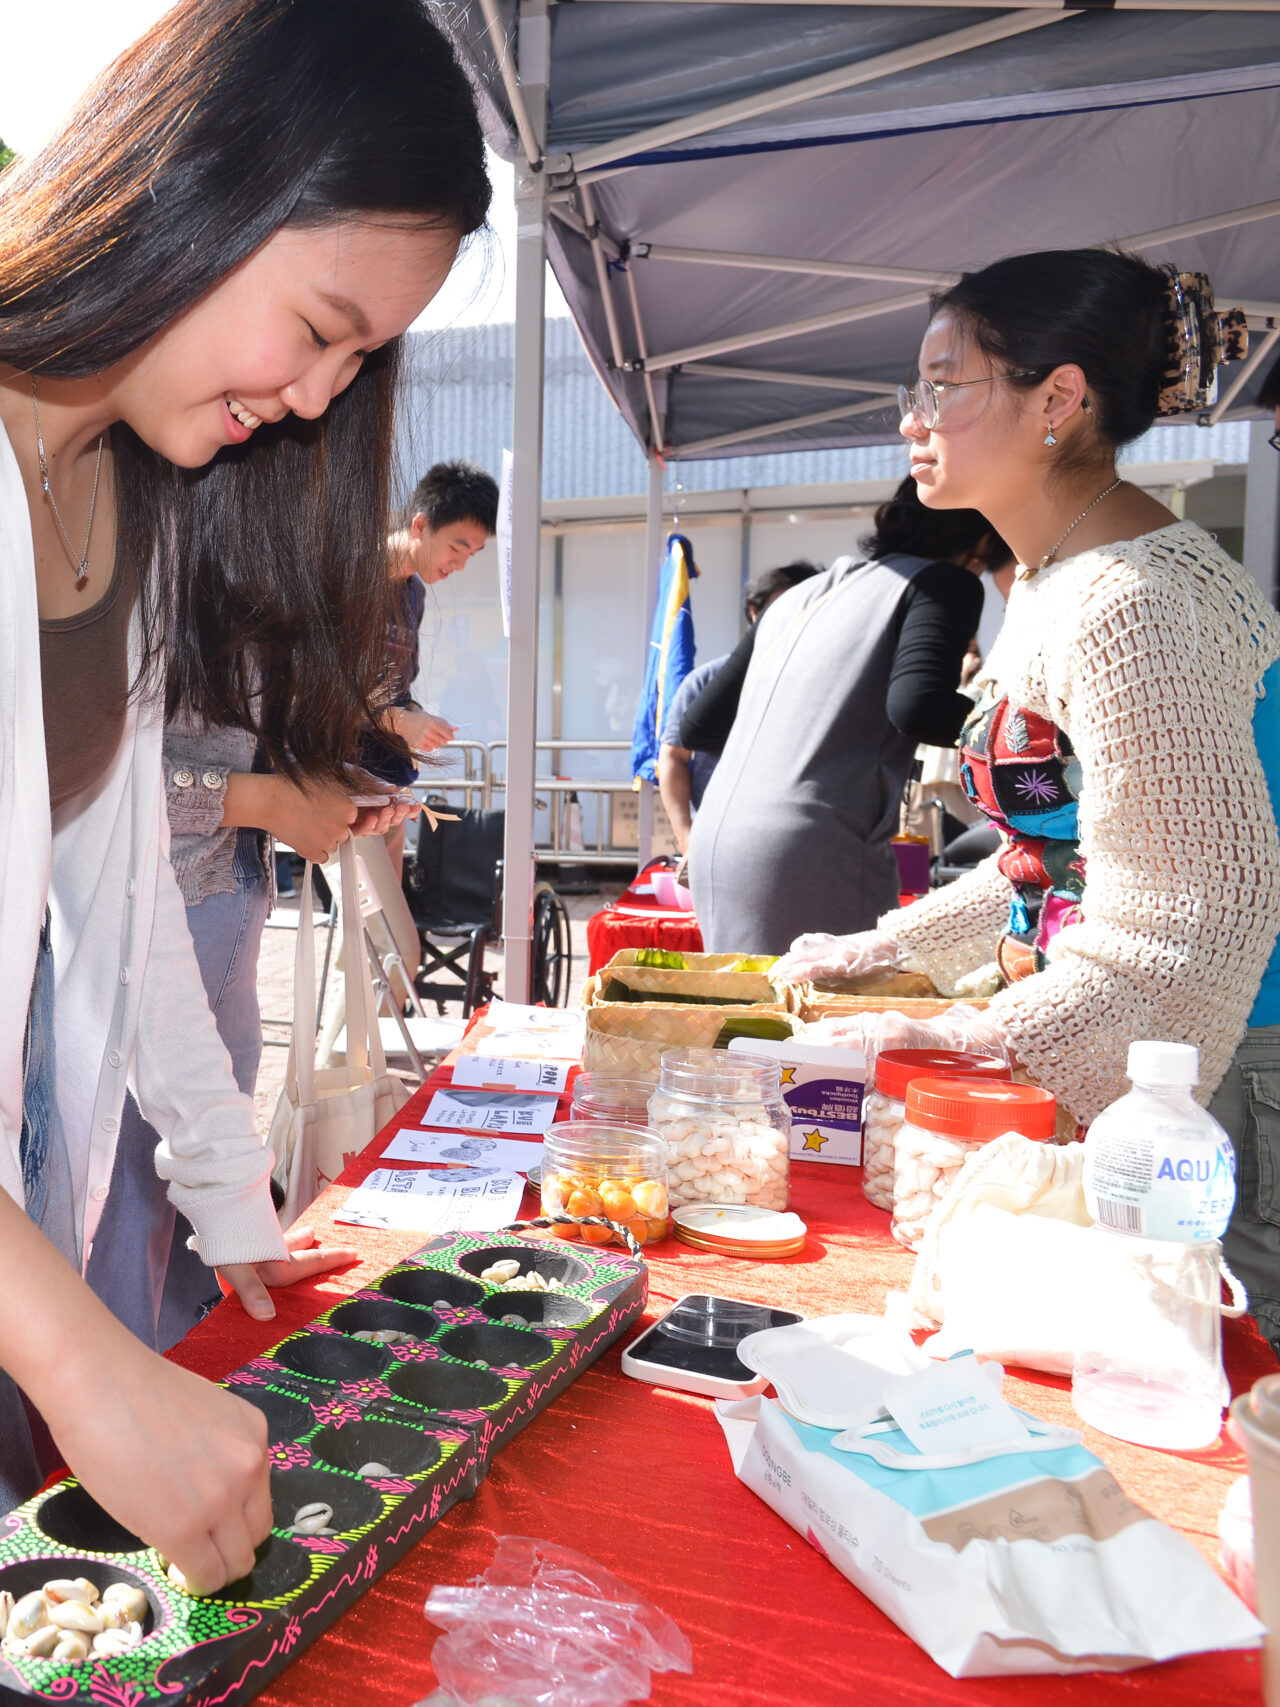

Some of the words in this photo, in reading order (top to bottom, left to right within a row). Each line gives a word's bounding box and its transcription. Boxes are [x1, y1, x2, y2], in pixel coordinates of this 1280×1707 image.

[821, 1090, 858, 1099] Toothpicks
[830, 1096, 858, 1104] Wooden
[486, 1109, 508, 1129] LAPIS
[517, 1109, 532, 1126] KUE
[789, 1105, 858, 1121] BESTbuy
